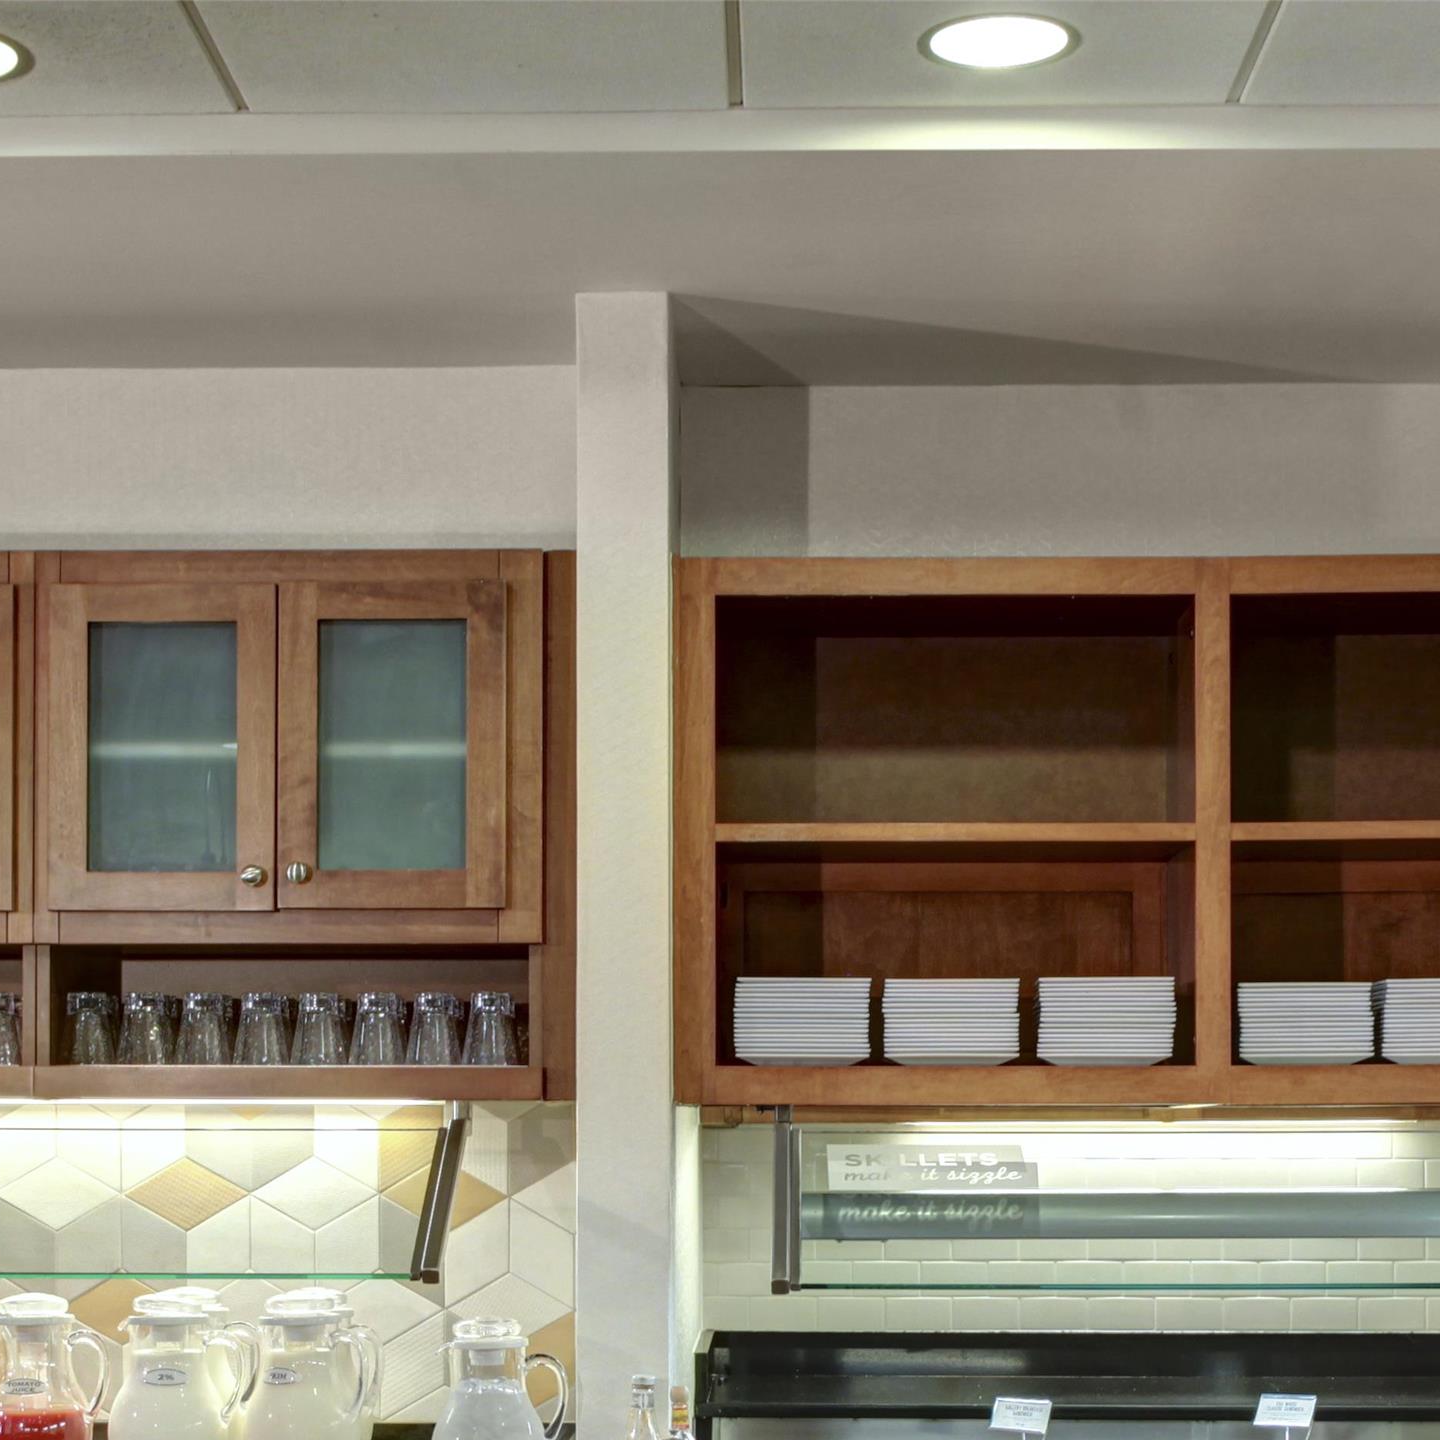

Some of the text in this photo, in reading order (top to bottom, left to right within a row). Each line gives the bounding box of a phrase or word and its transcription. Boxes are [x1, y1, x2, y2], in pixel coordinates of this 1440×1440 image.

[844, 1152, 999, 1168] SKLLETS
[920, 1167, 940, 1181] it
[947, 1166, 1023, 1185] sizzle
